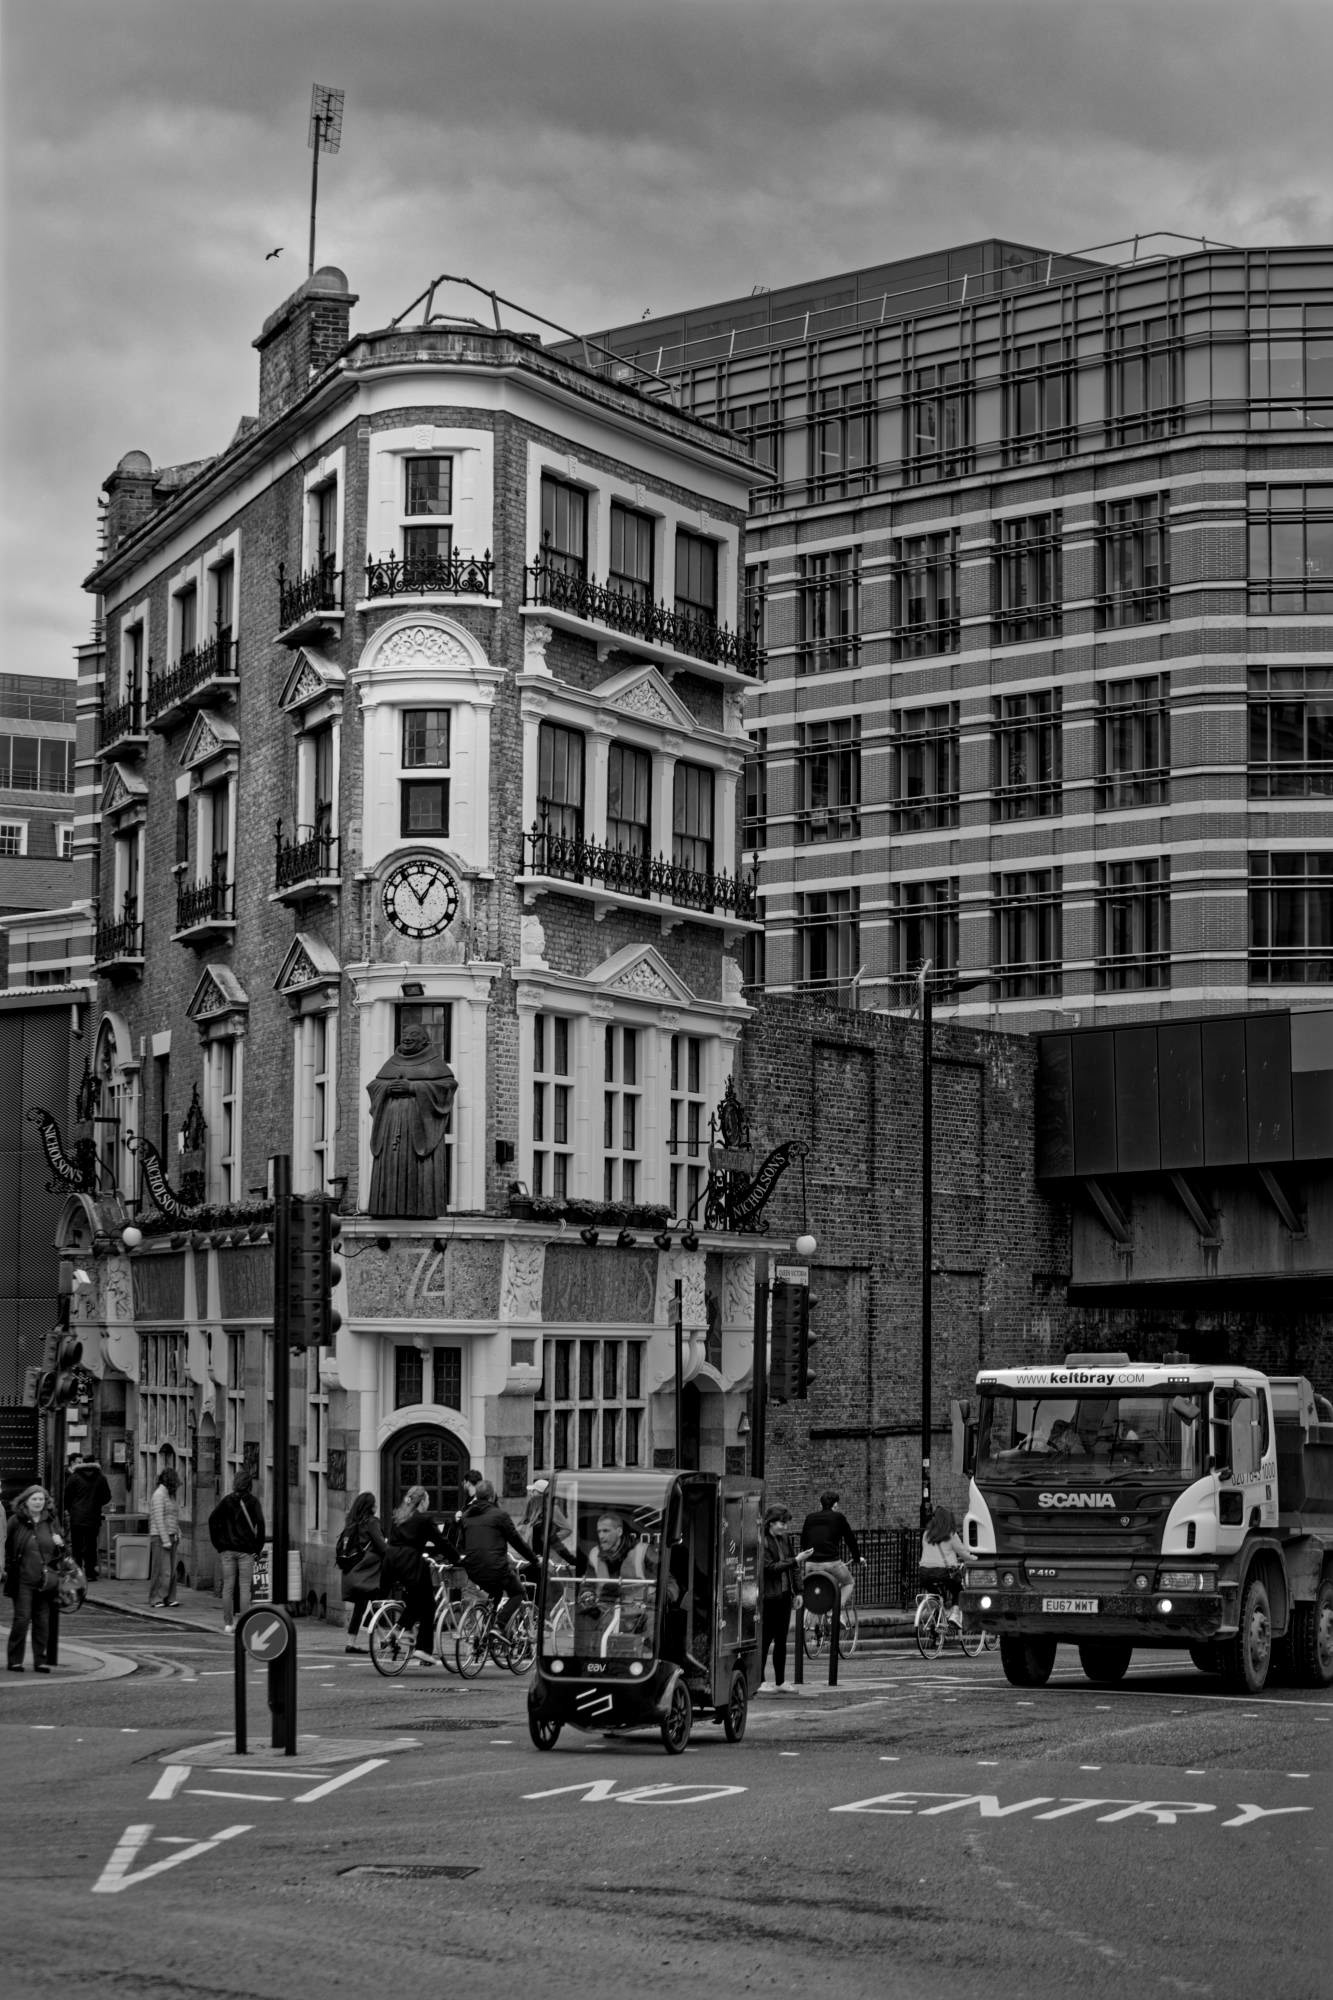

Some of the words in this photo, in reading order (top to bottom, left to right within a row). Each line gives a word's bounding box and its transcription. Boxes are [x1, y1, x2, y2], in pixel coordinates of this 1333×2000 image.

[1038, 1492, 1116, 1508] SCANIA
[1046, 1600, 1072, 1611] EU67
[587, 1663, 607, 1673] eav
[520, 1779, 749, 1805] NO
[828, 1791, 1315, 1827] ENTRY
